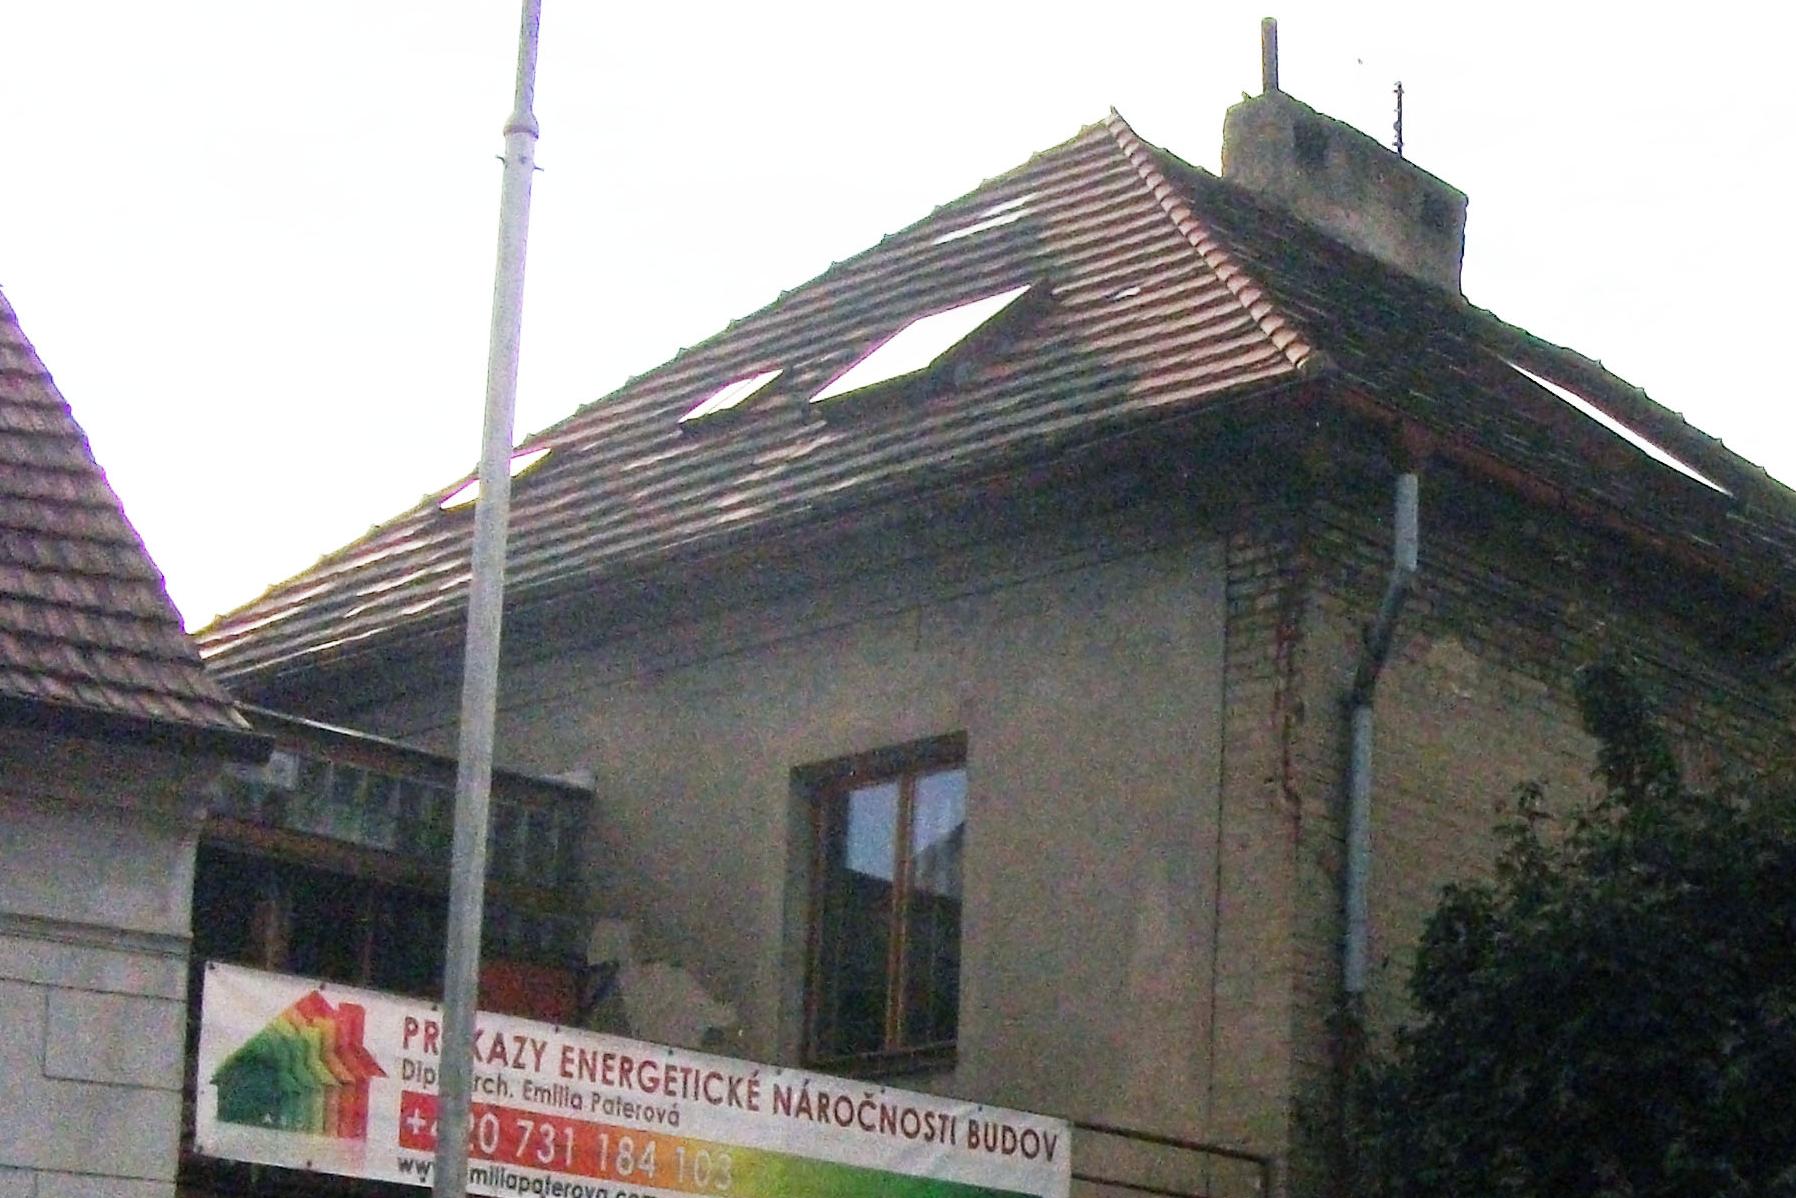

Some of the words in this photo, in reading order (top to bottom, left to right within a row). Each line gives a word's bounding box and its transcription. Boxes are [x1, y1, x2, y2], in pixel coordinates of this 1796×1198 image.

[402, 1016, 548, 1073] PRKAZY
[560, 1044, 760, 1112] ENERGETICKÉ
[772, 1079, 956, 1146] NÁROČNOSTI
[967, 1118, 1058, 1163] BUDOV
[402, 1058, 440, 1089] Dip
[469, 1072, 514, 1099] rch.
[523, 1078, 584, 1111] Emilia
[591, 1091, 681, 1128] Paterová
[404, 1107, 500, 1155] +0
[515, 1117, 575, 1169] 731
[599, 1132, 657, 1180] 184
[675, 1145, 734, 1190] 103
